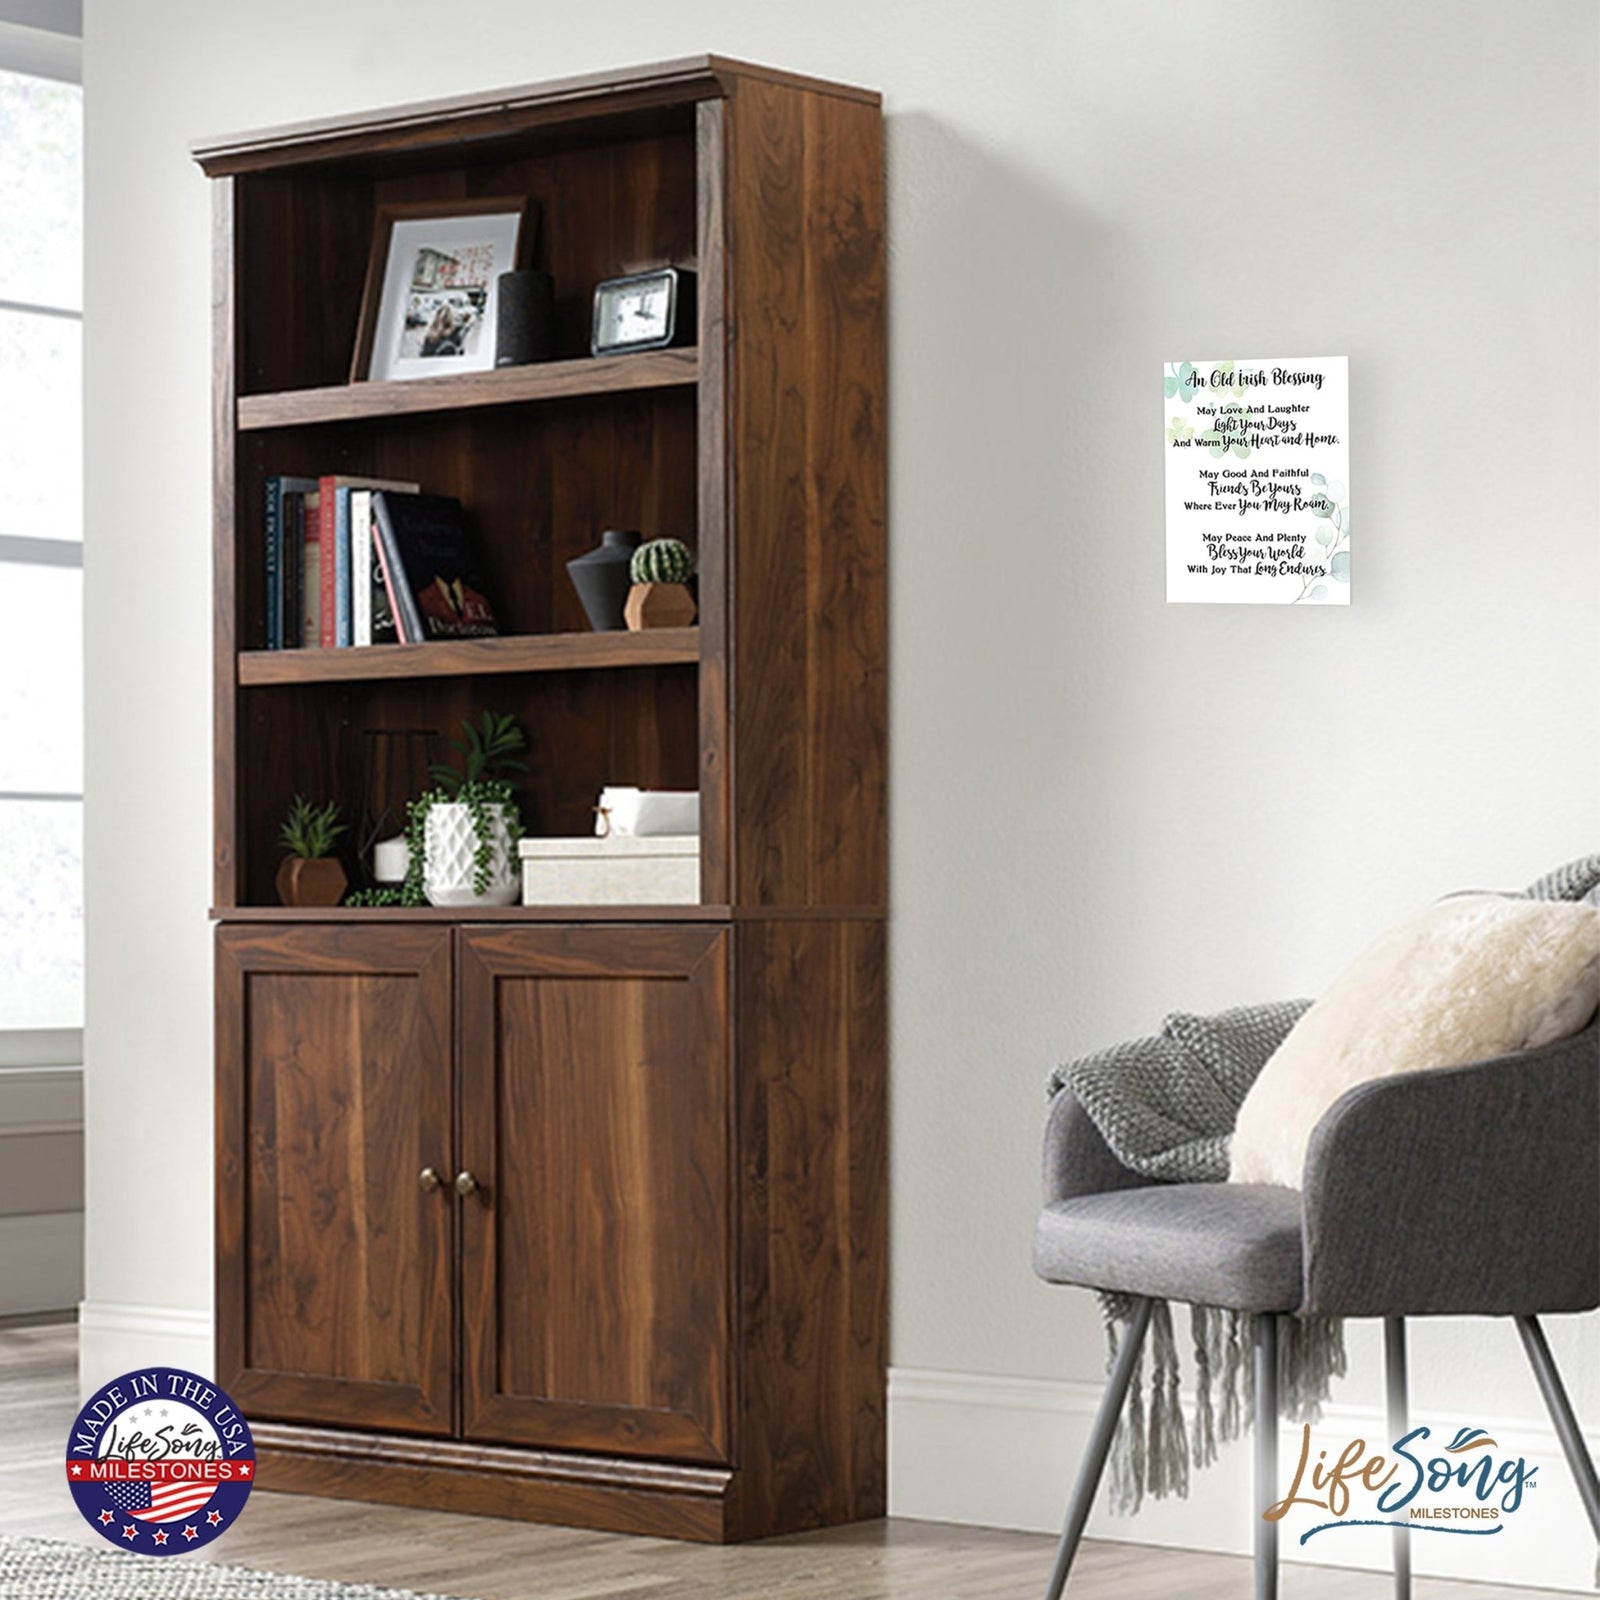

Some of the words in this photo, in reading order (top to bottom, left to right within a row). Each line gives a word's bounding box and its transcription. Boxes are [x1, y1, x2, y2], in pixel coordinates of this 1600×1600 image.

[1184, 370, 1208, 388] An
[1210, 369, 1235, 388] Old
[1238, 369, 1268, 387] Irish
[1271, 367, 1325, 390] Blessing
[1197, 406, 1216, 416] May
[1220, 406, 1243, 414] Love
[1246, 405, 1264, 414] And
[1268, 404, 1310, 416] Laughter
[1213, 416, 1238, 434] Light
[1240, 418, 1266, 436] Your
[1266, 416, 1297, 433] Days
[1173, 438, 1191, 448] And
[1194, 438, 1220, 447] Warm
[1222, 435, 1250, 452] Your
[1250, 433, 1282, 450] Heart
[1282, 432, 1303, 446] and
[1304, 432, 1340, 448] Home.
[1199, 470, 1220, 480] May
[1222, 470, 1248, 478] Good
[1250, 469, 1270, 478] And
[1272, 468, 1310, 478] Faithful
[1207, 480, 1249, 497] Friends
[1250, 479, 1268, 497] Be
[1268, 482, 1302, 500] Yours
[1184, 502, 1212, 510] Where
[1214, 502, 1237, 510] Ever
[1238, 498, 1261, 516] You
[1262, 498, 1292, 514] May
[1293, 497, 1330, 512] Roam.
[1202, 533, 1222, 544] May
[1225, 533, 1252, 542] Peace
[1255, 533, 1274, 542] And
[1276, 532, 1306, 544] Plenty
[1206, 543, 1238, 560] Bless
[1238, 546, 1268, 564] Your
[1267, 544, 1306, 562] World
[1187, 564, 1208, 574] With
[1211, 564, 1227, 576] Joy
[1230, 564, 1252, 574] That
[1254, 562, 1278, 578] Long
